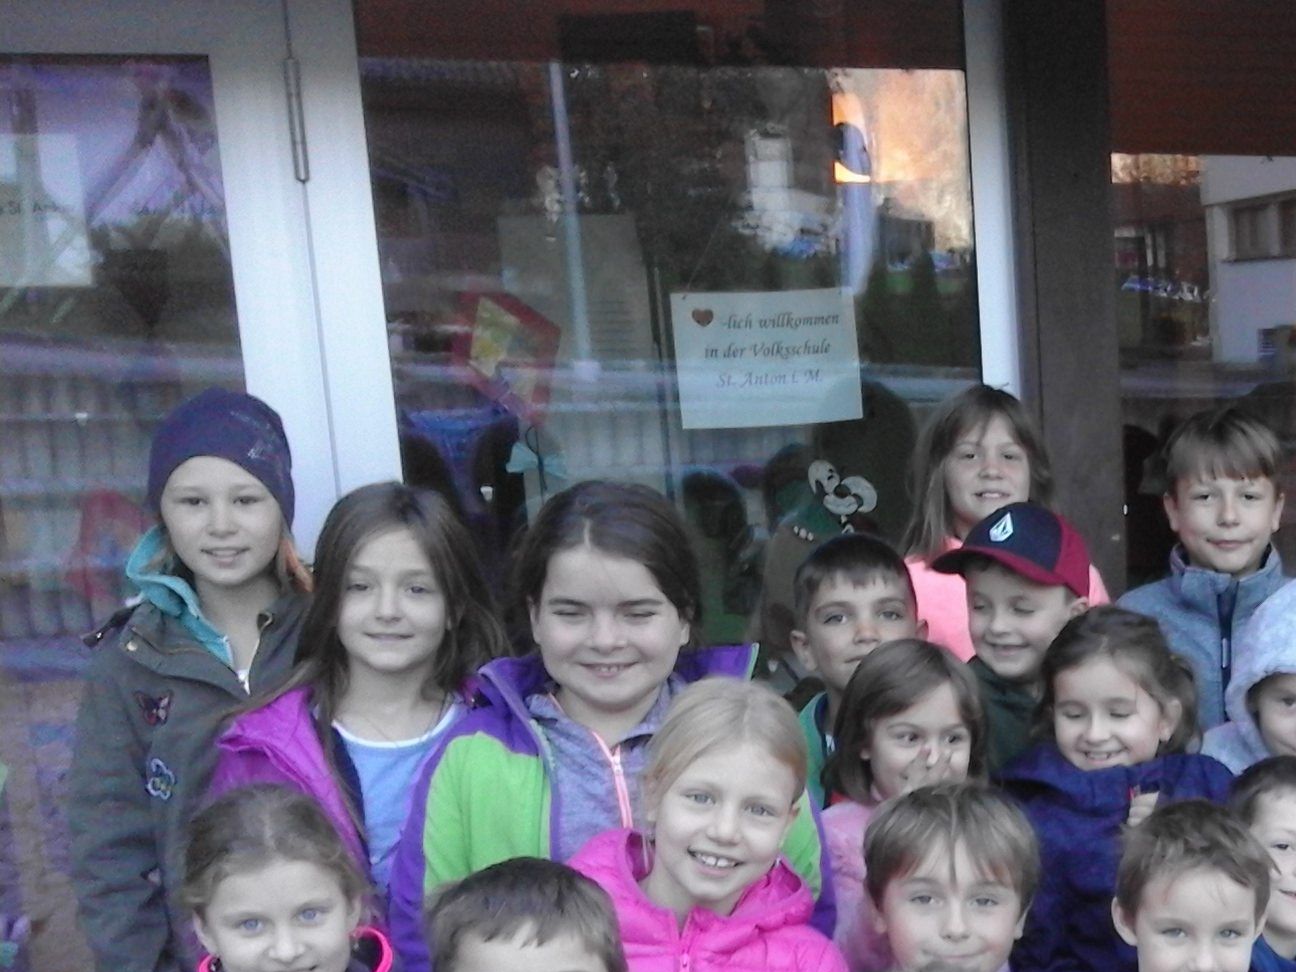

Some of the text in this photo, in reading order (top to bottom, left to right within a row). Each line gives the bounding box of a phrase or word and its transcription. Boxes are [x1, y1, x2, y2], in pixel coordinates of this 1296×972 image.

[759, 311, 840, 330] willkommen
[704, 338, 831, 360] in der Volksschule
[716, 373, 736, 388] St.
[740, 370, 787, 388] Anton
